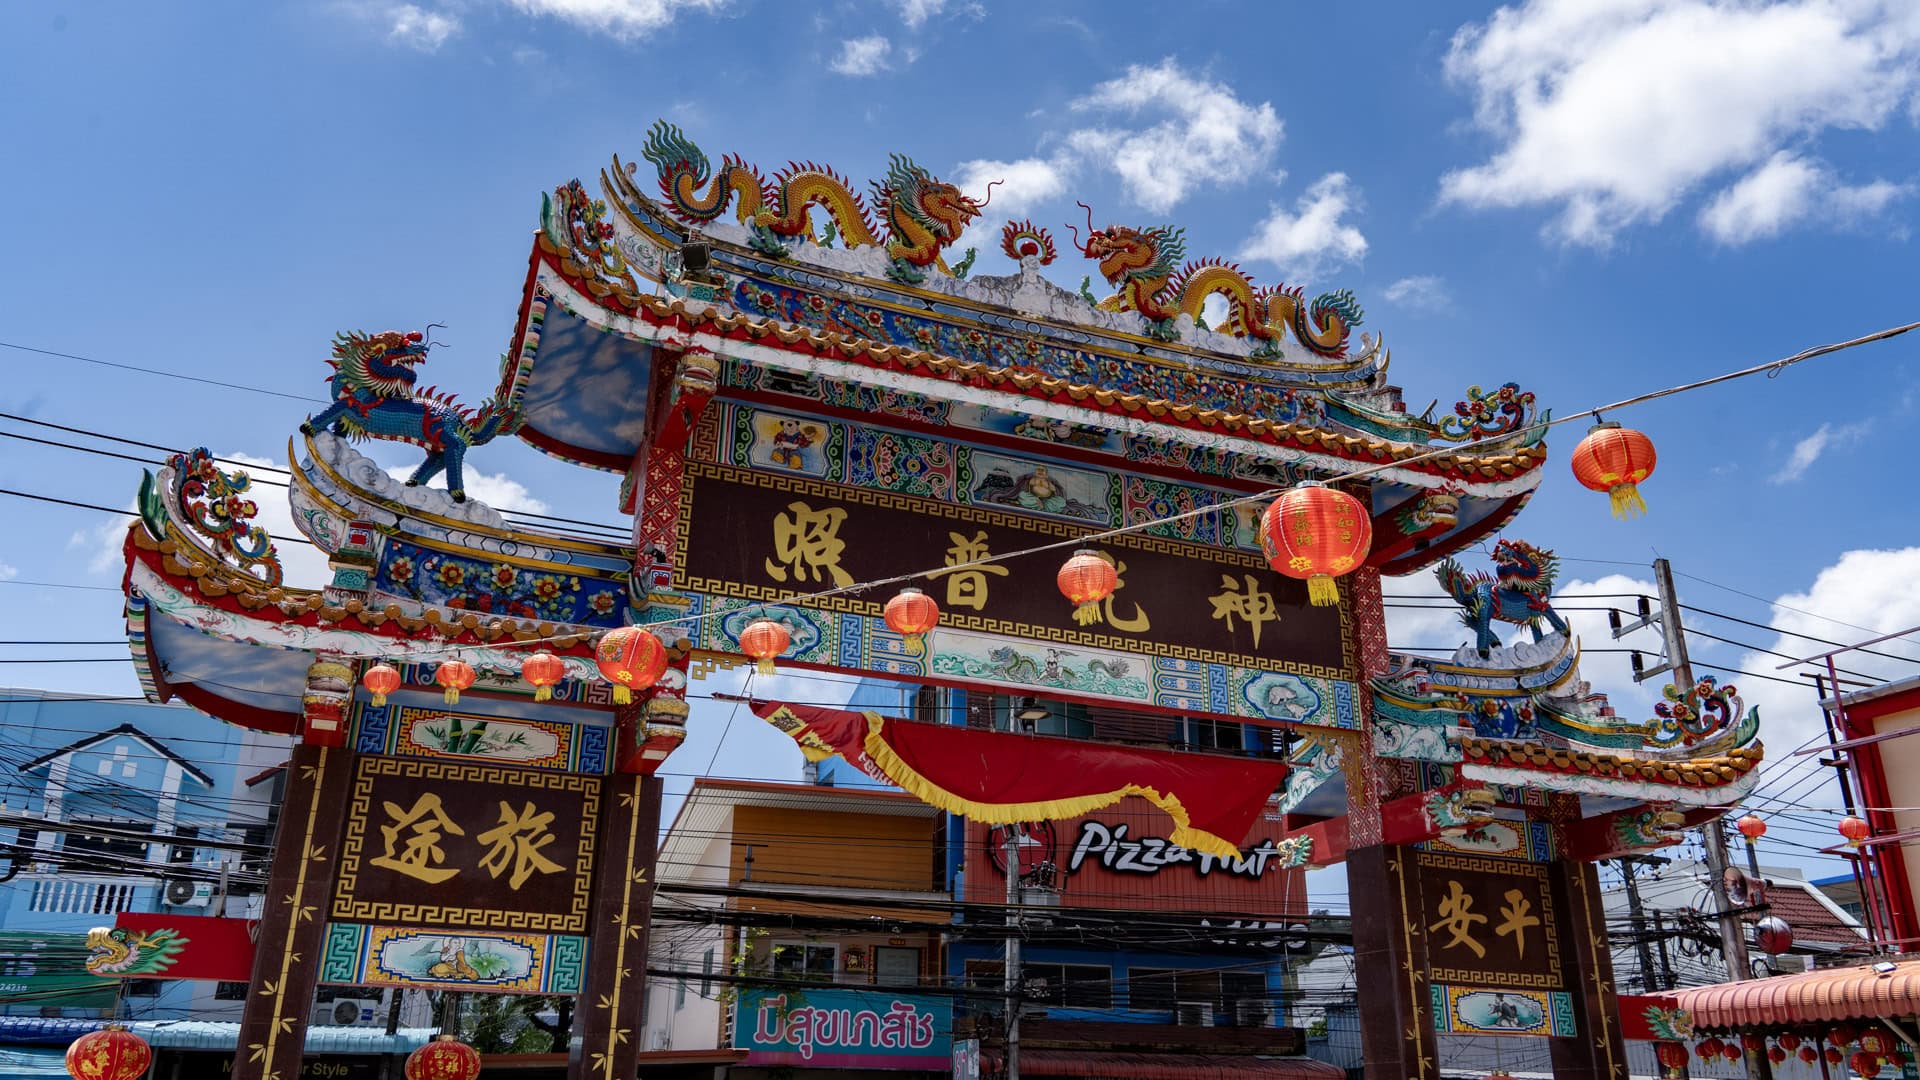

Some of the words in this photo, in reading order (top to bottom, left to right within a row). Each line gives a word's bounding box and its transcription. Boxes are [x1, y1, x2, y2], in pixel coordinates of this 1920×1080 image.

[1071, 821, 1193, 873] Pizza
[753, 993, 935, 1060] มีสุขเภสัช
[312, 1062, 349, 1079] Style
